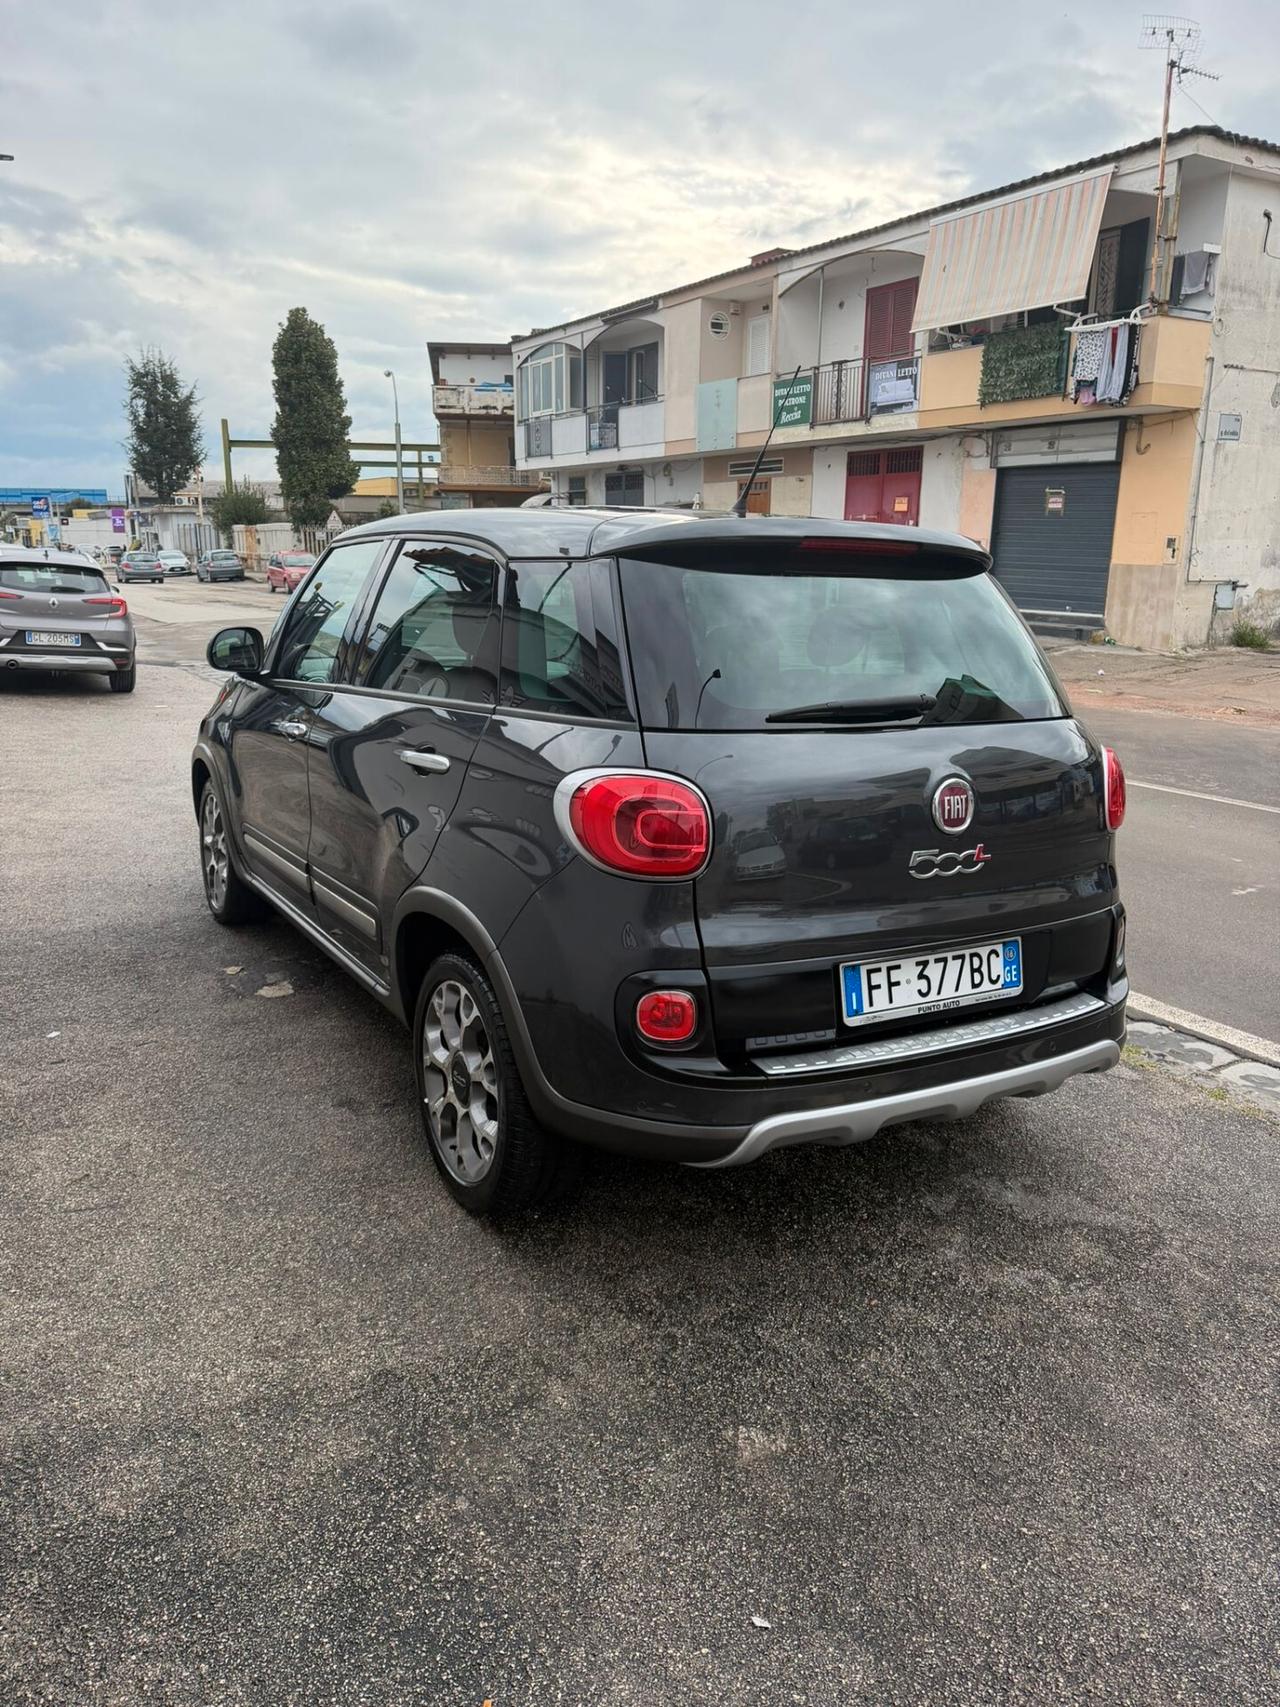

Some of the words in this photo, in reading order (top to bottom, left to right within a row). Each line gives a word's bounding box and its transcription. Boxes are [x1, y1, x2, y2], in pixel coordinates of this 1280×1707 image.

[897, 366, 917, 377] LETTO
[794, 384, 811, 394] LETTO
[944, 794, 967, 819] FIAT
[866, 964, 901, 1007] FF
[915, 949, 1001, 998] 377BC
[1005, 965, 1017, 982] GE
[917, 1003, 941, 1013] PUNTO
[942, 1000, 960, 1009] AUTO
